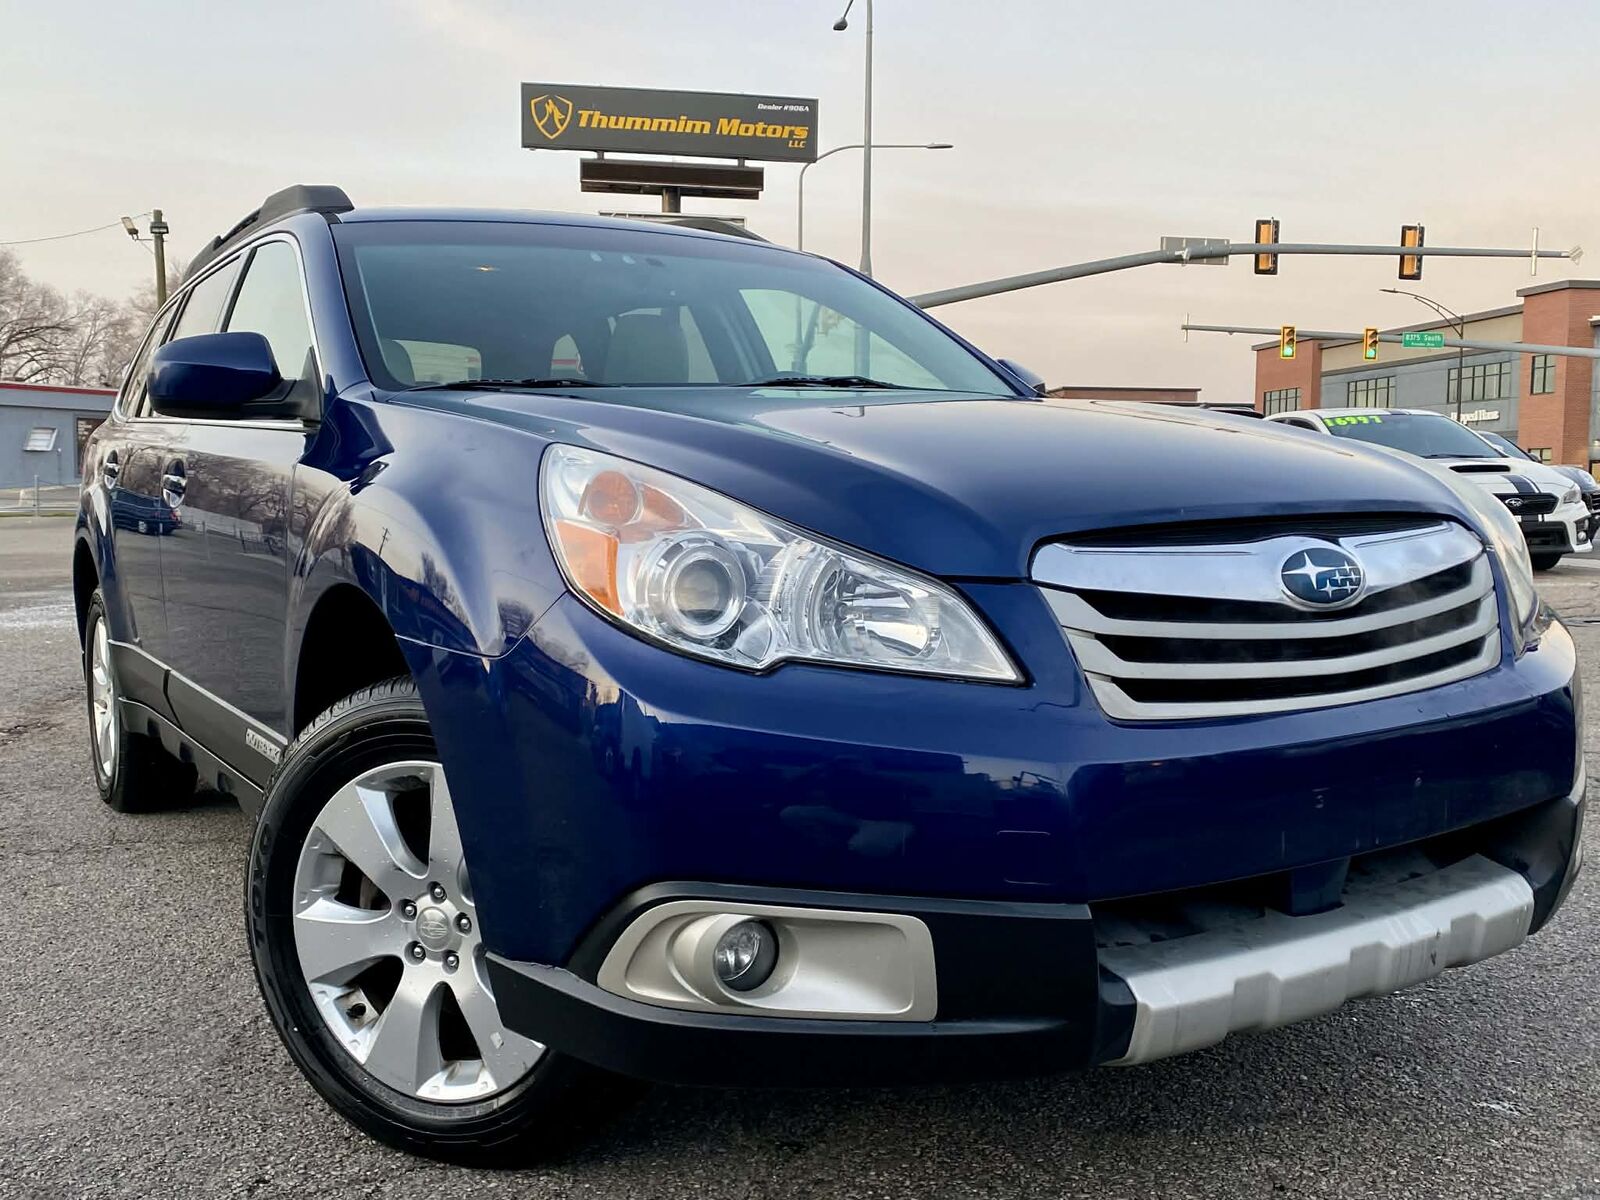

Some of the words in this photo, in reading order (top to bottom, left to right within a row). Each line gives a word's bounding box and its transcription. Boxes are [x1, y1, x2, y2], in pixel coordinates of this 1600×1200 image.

[757, 103, 783, 111] Dealer
[577, 109, 711, 135] Thummim
[716, 118, 809, 140] Motors
[788, 140, 807, 148] LLC
[1323, 415, 1382, 427] 16997
